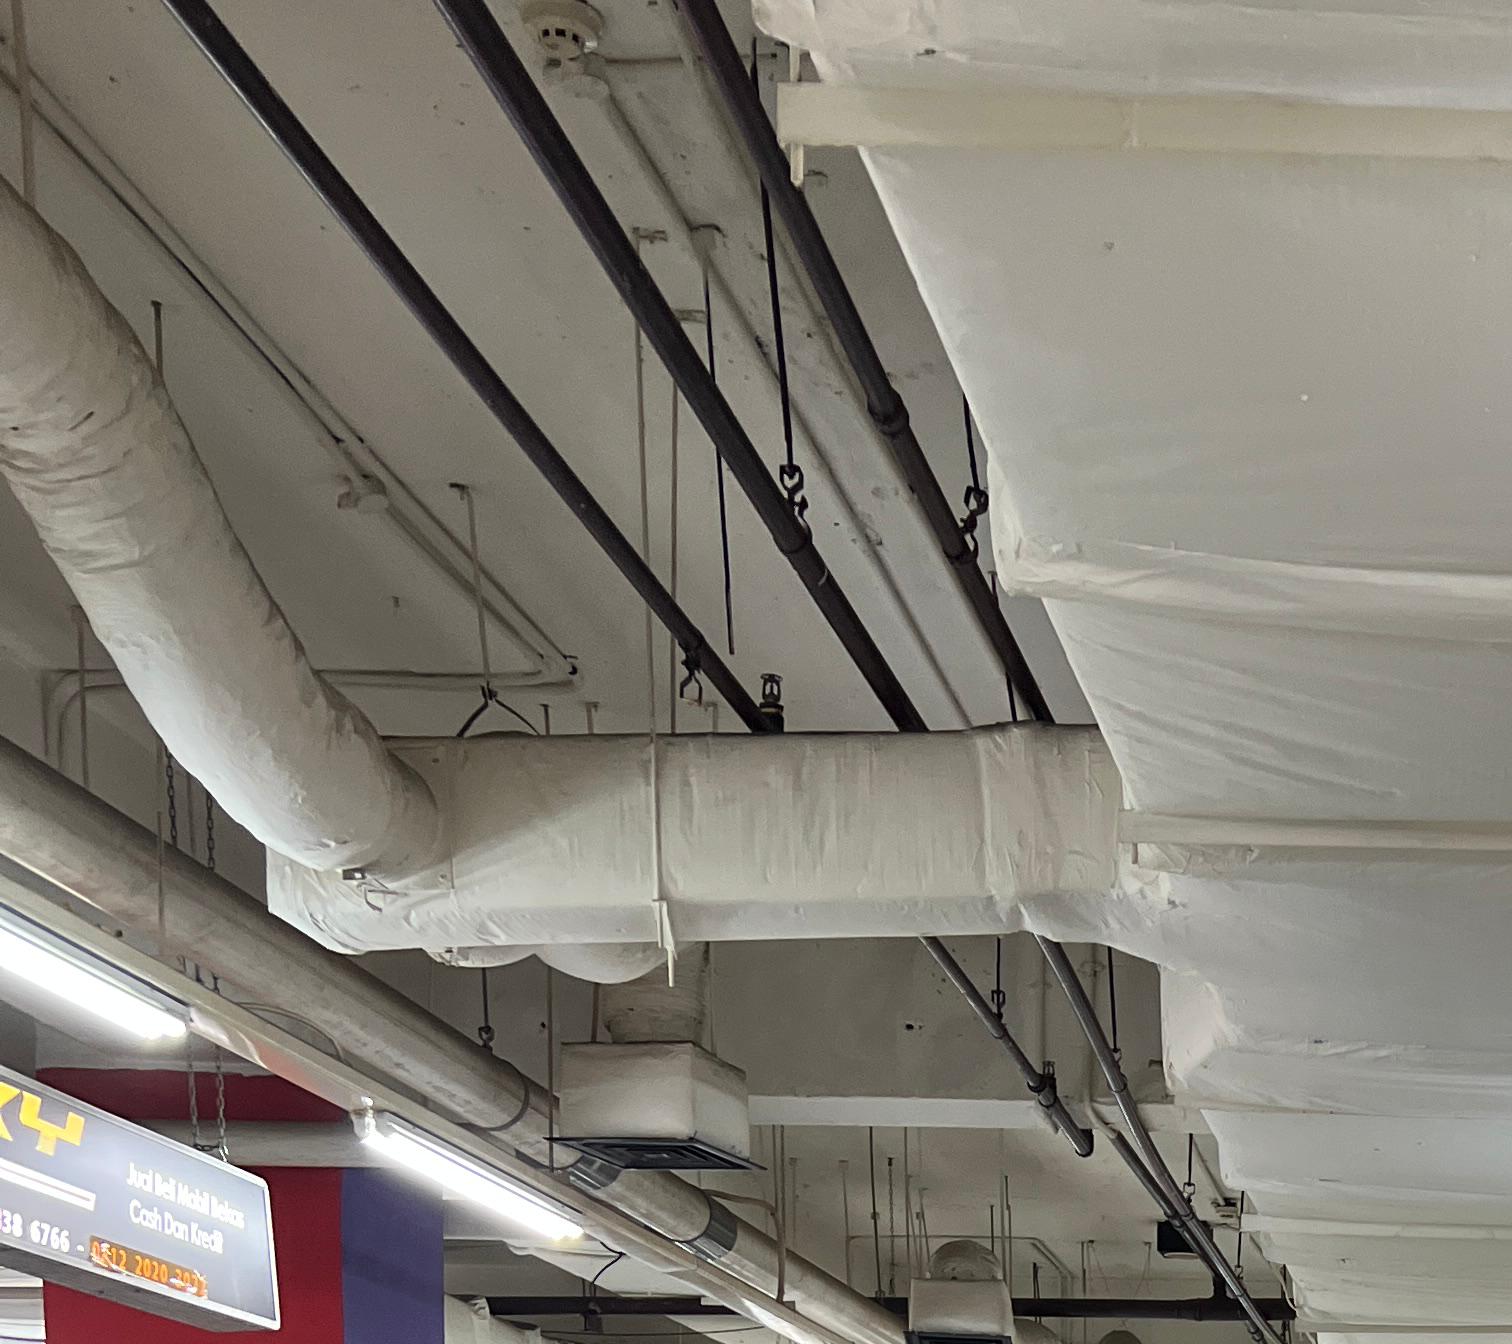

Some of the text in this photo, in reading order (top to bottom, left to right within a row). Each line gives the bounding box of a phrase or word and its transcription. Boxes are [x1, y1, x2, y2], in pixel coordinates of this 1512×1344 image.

[30, 1219, 70, 1253] 6766
[129, 1199, 224, 1254] Cash Dan Kredit
